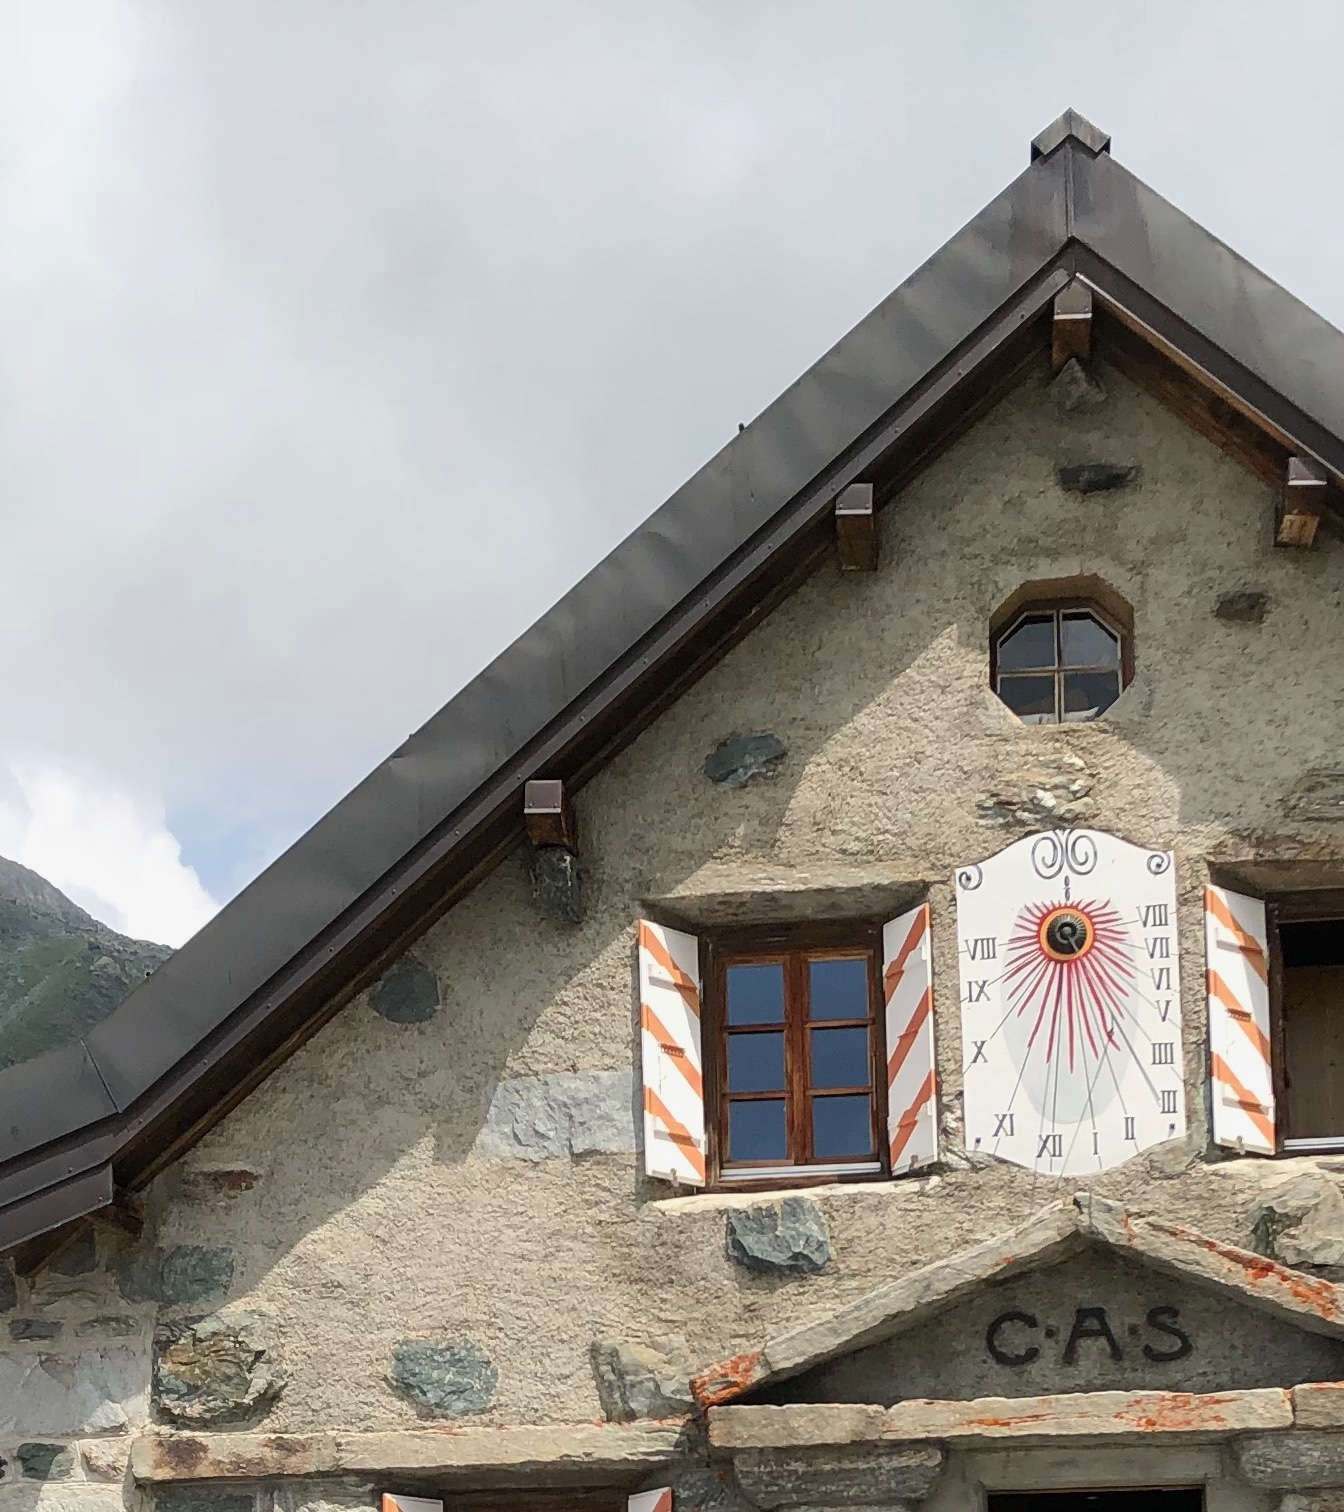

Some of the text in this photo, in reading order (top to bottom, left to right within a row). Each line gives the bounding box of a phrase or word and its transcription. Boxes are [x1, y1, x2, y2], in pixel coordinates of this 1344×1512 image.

[965, 937, 997, 960] VIII
[1145, 937, 1170, 959] VII
[1150, 967, 1171, 990] VI
[967, 980, 991, 1002] IX
[1156, 1000, 1171, 1022] V
[971, 1040, 988, 1063] X
[1160, 1090, 1178, 1113] III
[992, 1113, 1015, 1136] XI
[1124, 1116, 1136, 1140] II
[1036, 1134, 1063, 1157] XII
[1092, 1132, 1099, 1155] I
